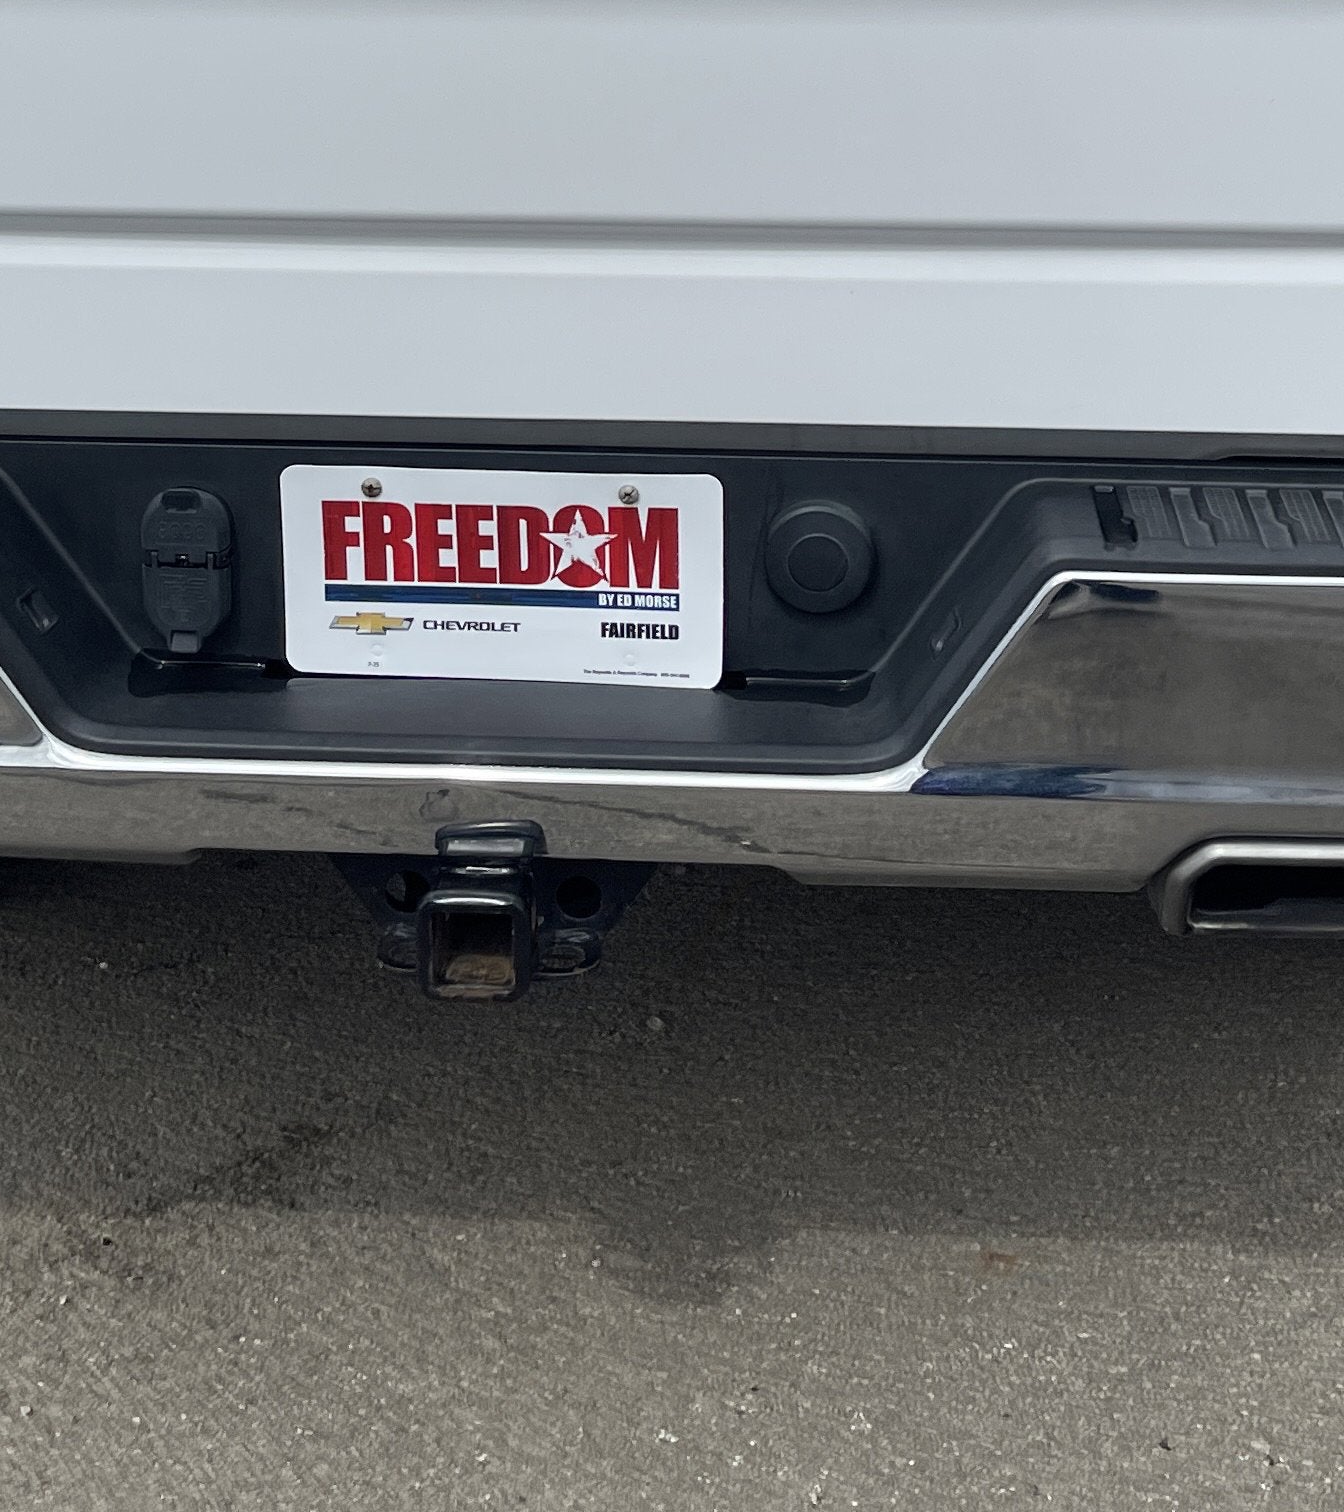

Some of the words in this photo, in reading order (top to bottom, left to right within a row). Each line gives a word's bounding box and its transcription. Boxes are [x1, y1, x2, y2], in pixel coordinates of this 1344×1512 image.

[321, 499, 680, 590] FREEDOM
[598, 592, 615, 606] BY
[616, 593, 633, 607] ED
[634, 594, 678, 609] MORSE
[422, 619, 522, 633] CHEVROLET
[600, 621, 680, 641] FAIRFIELD
